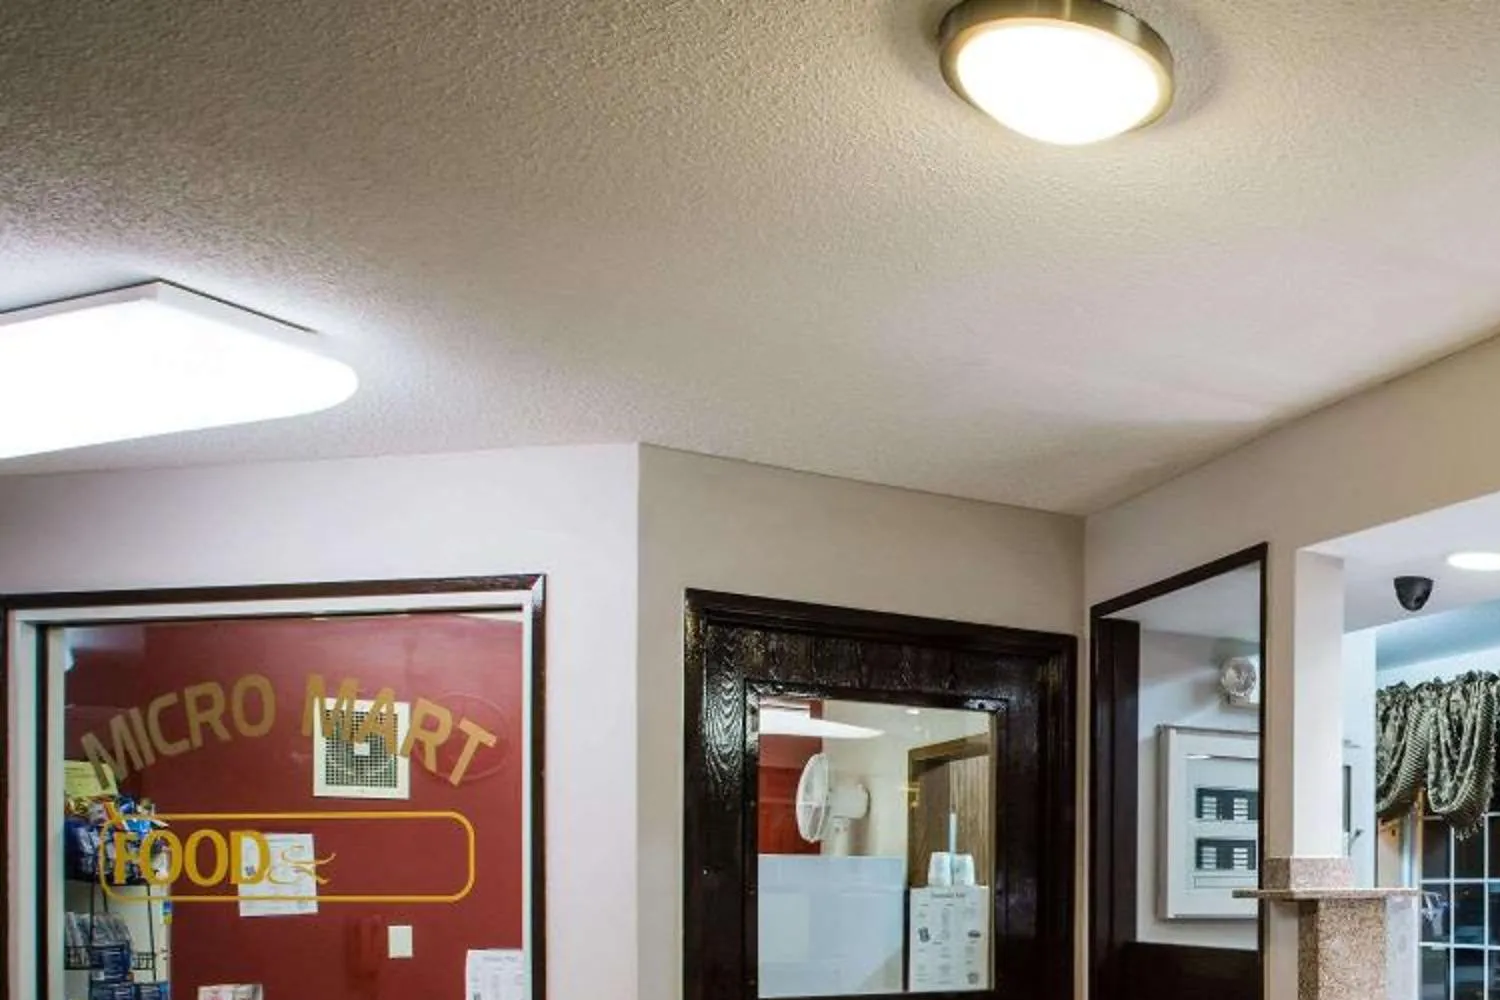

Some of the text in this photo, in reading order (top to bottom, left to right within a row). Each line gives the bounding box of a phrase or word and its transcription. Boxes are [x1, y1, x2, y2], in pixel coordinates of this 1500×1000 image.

[81, 673, 497, 790] MICRO MART
[112, 829, 271, 886] FOOD
